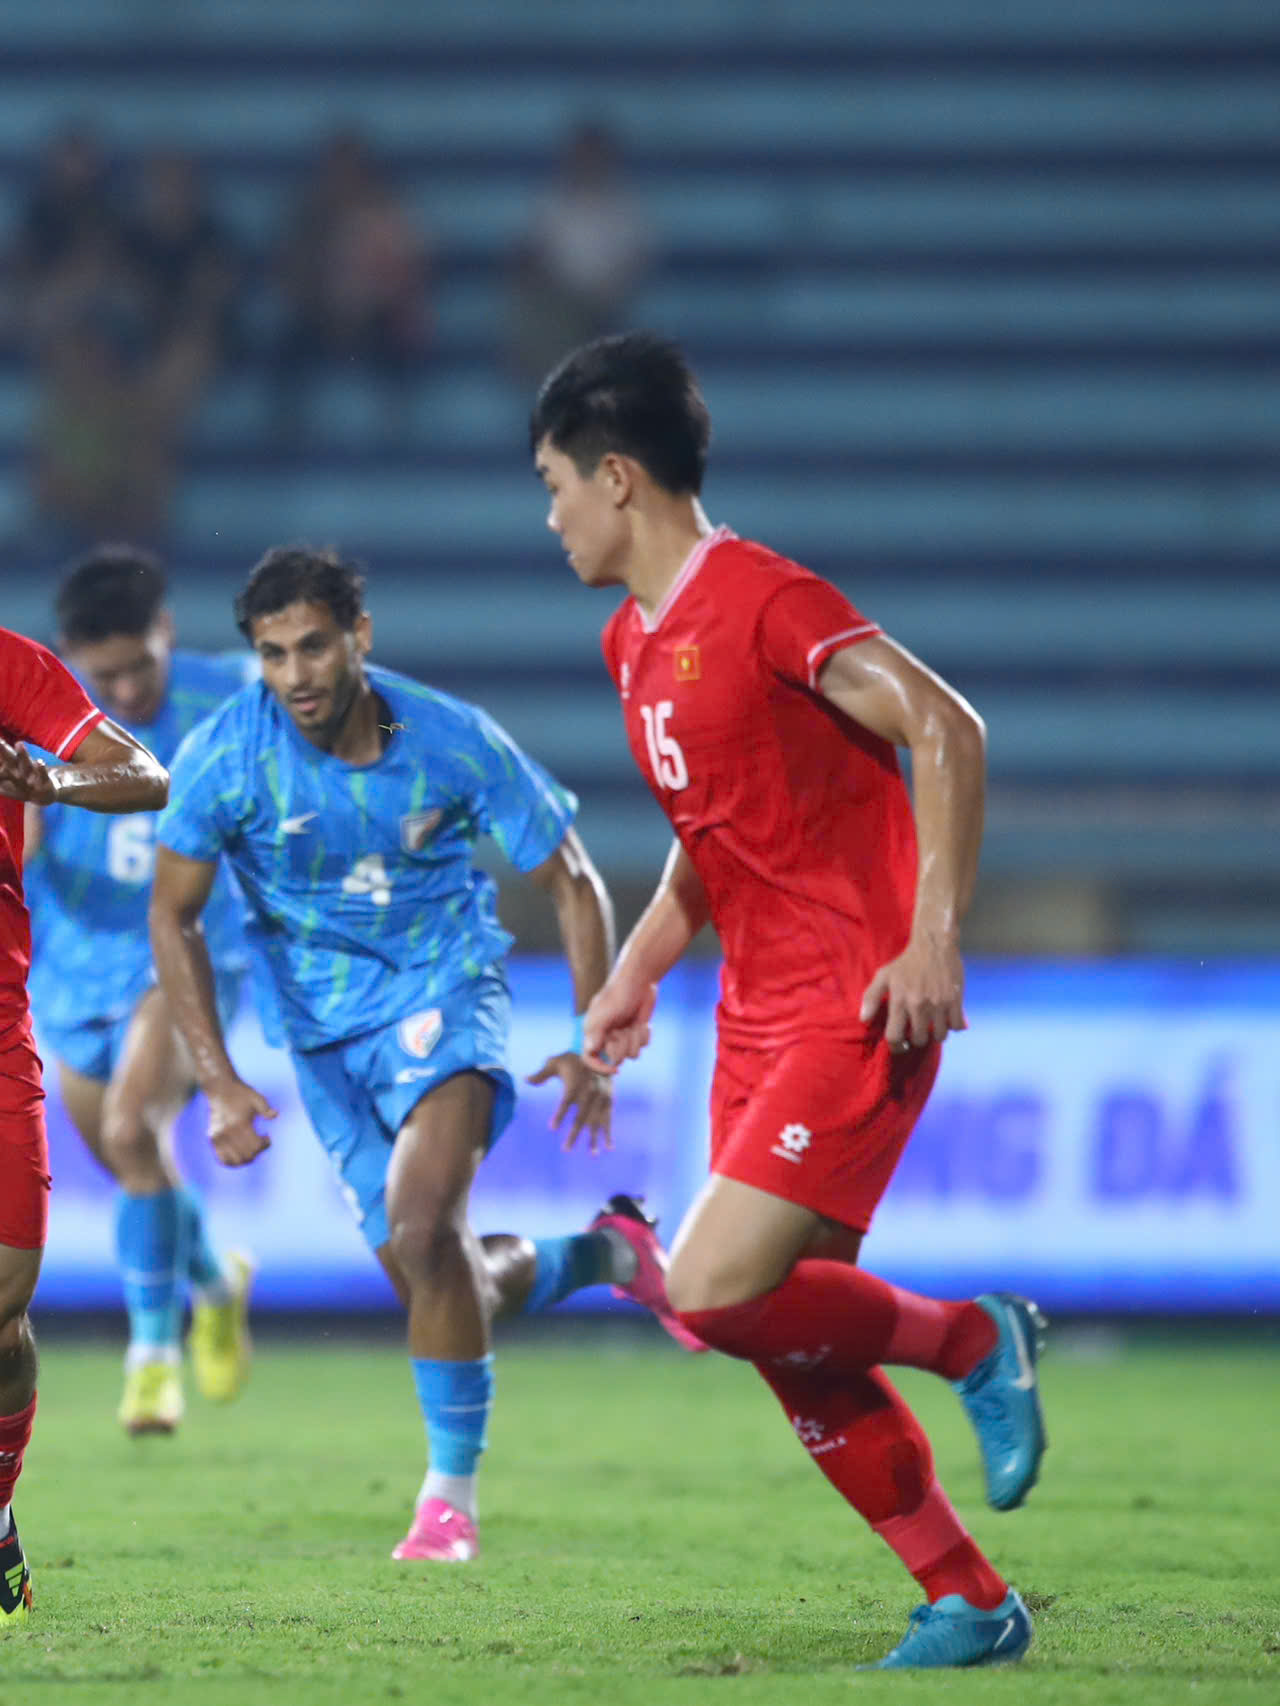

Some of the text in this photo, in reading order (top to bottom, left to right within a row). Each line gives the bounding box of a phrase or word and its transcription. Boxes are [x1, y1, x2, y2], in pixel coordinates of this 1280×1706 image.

[640, 701, 689, 791] 15
[107, 814, 156, 884] 6
[342, 852, 394, 906] 4
